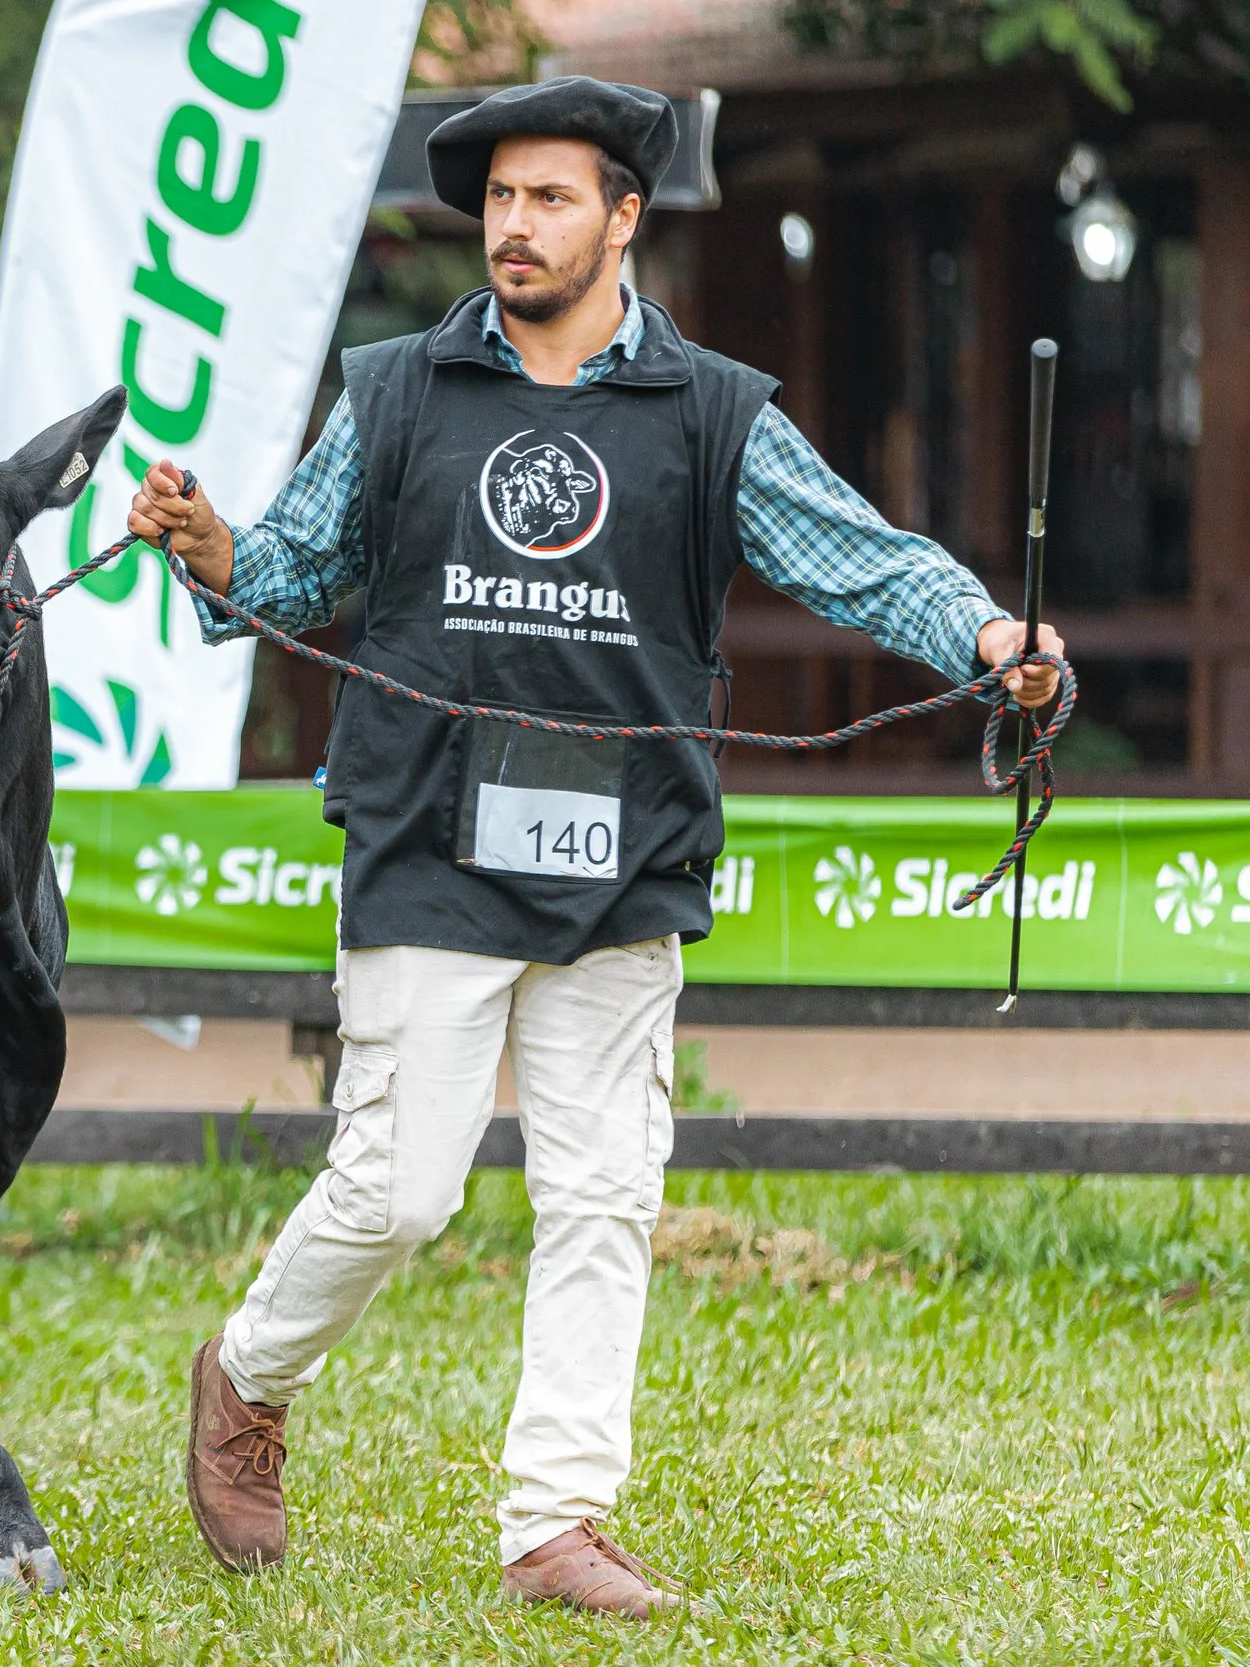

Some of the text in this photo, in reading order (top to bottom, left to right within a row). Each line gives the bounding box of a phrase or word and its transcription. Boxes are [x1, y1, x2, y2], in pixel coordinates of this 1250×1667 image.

[69, 0, 301, 648] Scred
[507, 621, 571, 640] BRASILEIRA
[573, 628, 588, 641] DE
[590, 630, 639, 647] BRANGUS
[526, 820, 613, 865] 140
[214, 846, 343, 906] Sicr
